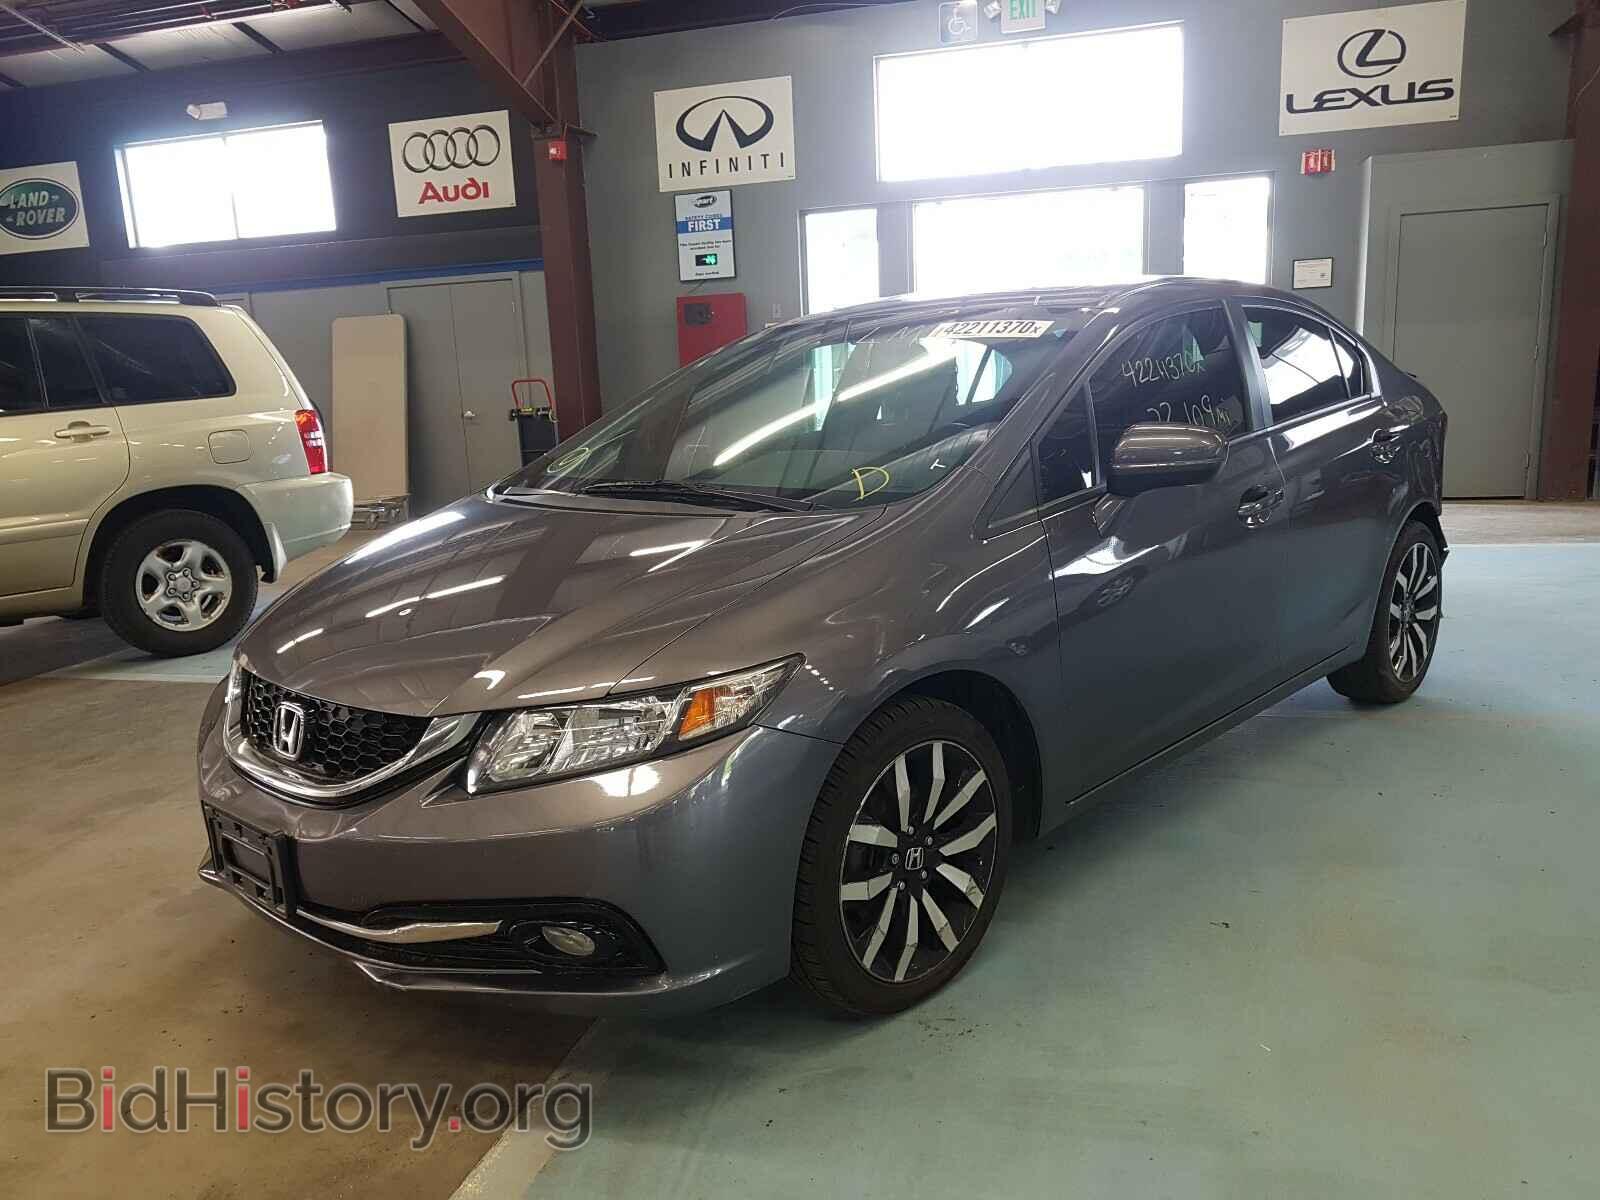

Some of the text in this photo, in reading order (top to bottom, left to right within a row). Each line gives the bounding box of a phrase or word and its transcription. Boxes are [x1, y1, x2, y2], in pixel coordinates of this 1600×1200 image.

[1286, 78, 1454, 114] LEXUS
[668, 152, 784, 178] INFINITI
[9, 190, 49, 208] LAND
[418, 177, 489, 204] Audi
[16, 207, 66, 226] ROVER
[687, 219, 721, 232] FIRST
